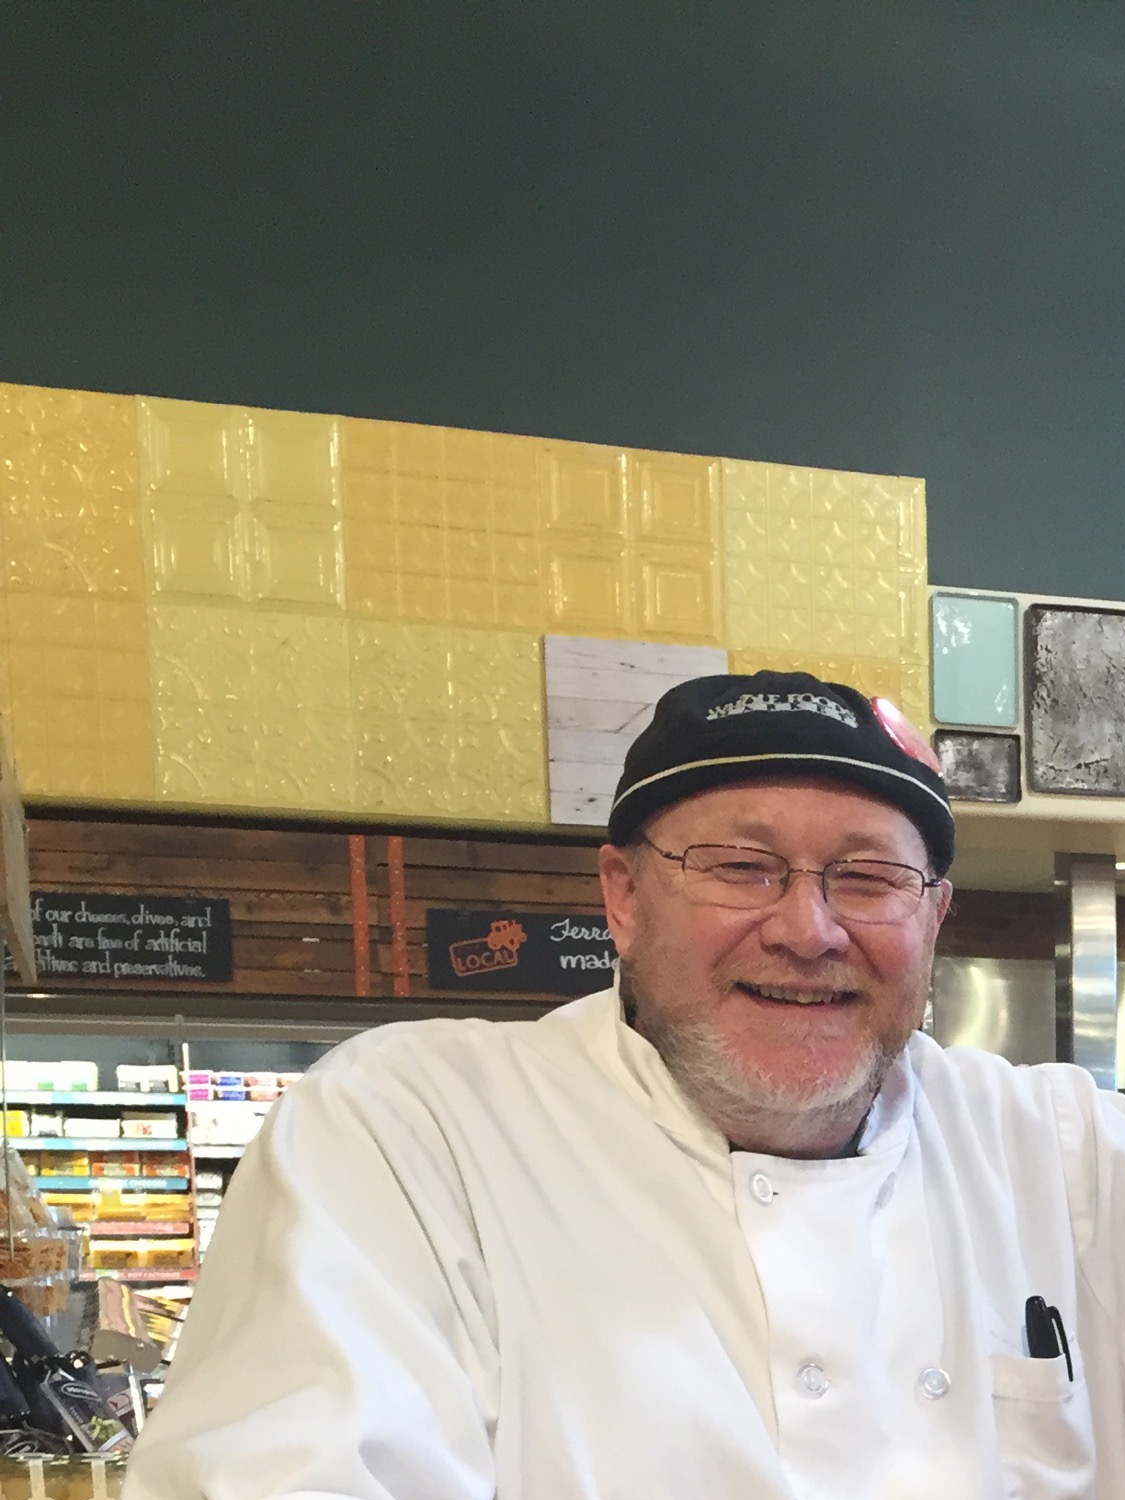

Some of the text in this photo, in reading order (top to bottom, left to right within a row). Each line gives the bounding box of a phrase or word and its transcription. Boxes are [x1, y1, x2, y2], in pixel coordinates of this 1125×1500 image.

[180, 906, 212, 928] and
[124, 930, 143, 951] of
[82, 951, 111, 974] and
[456, 949, 514, 972] LOCAL
